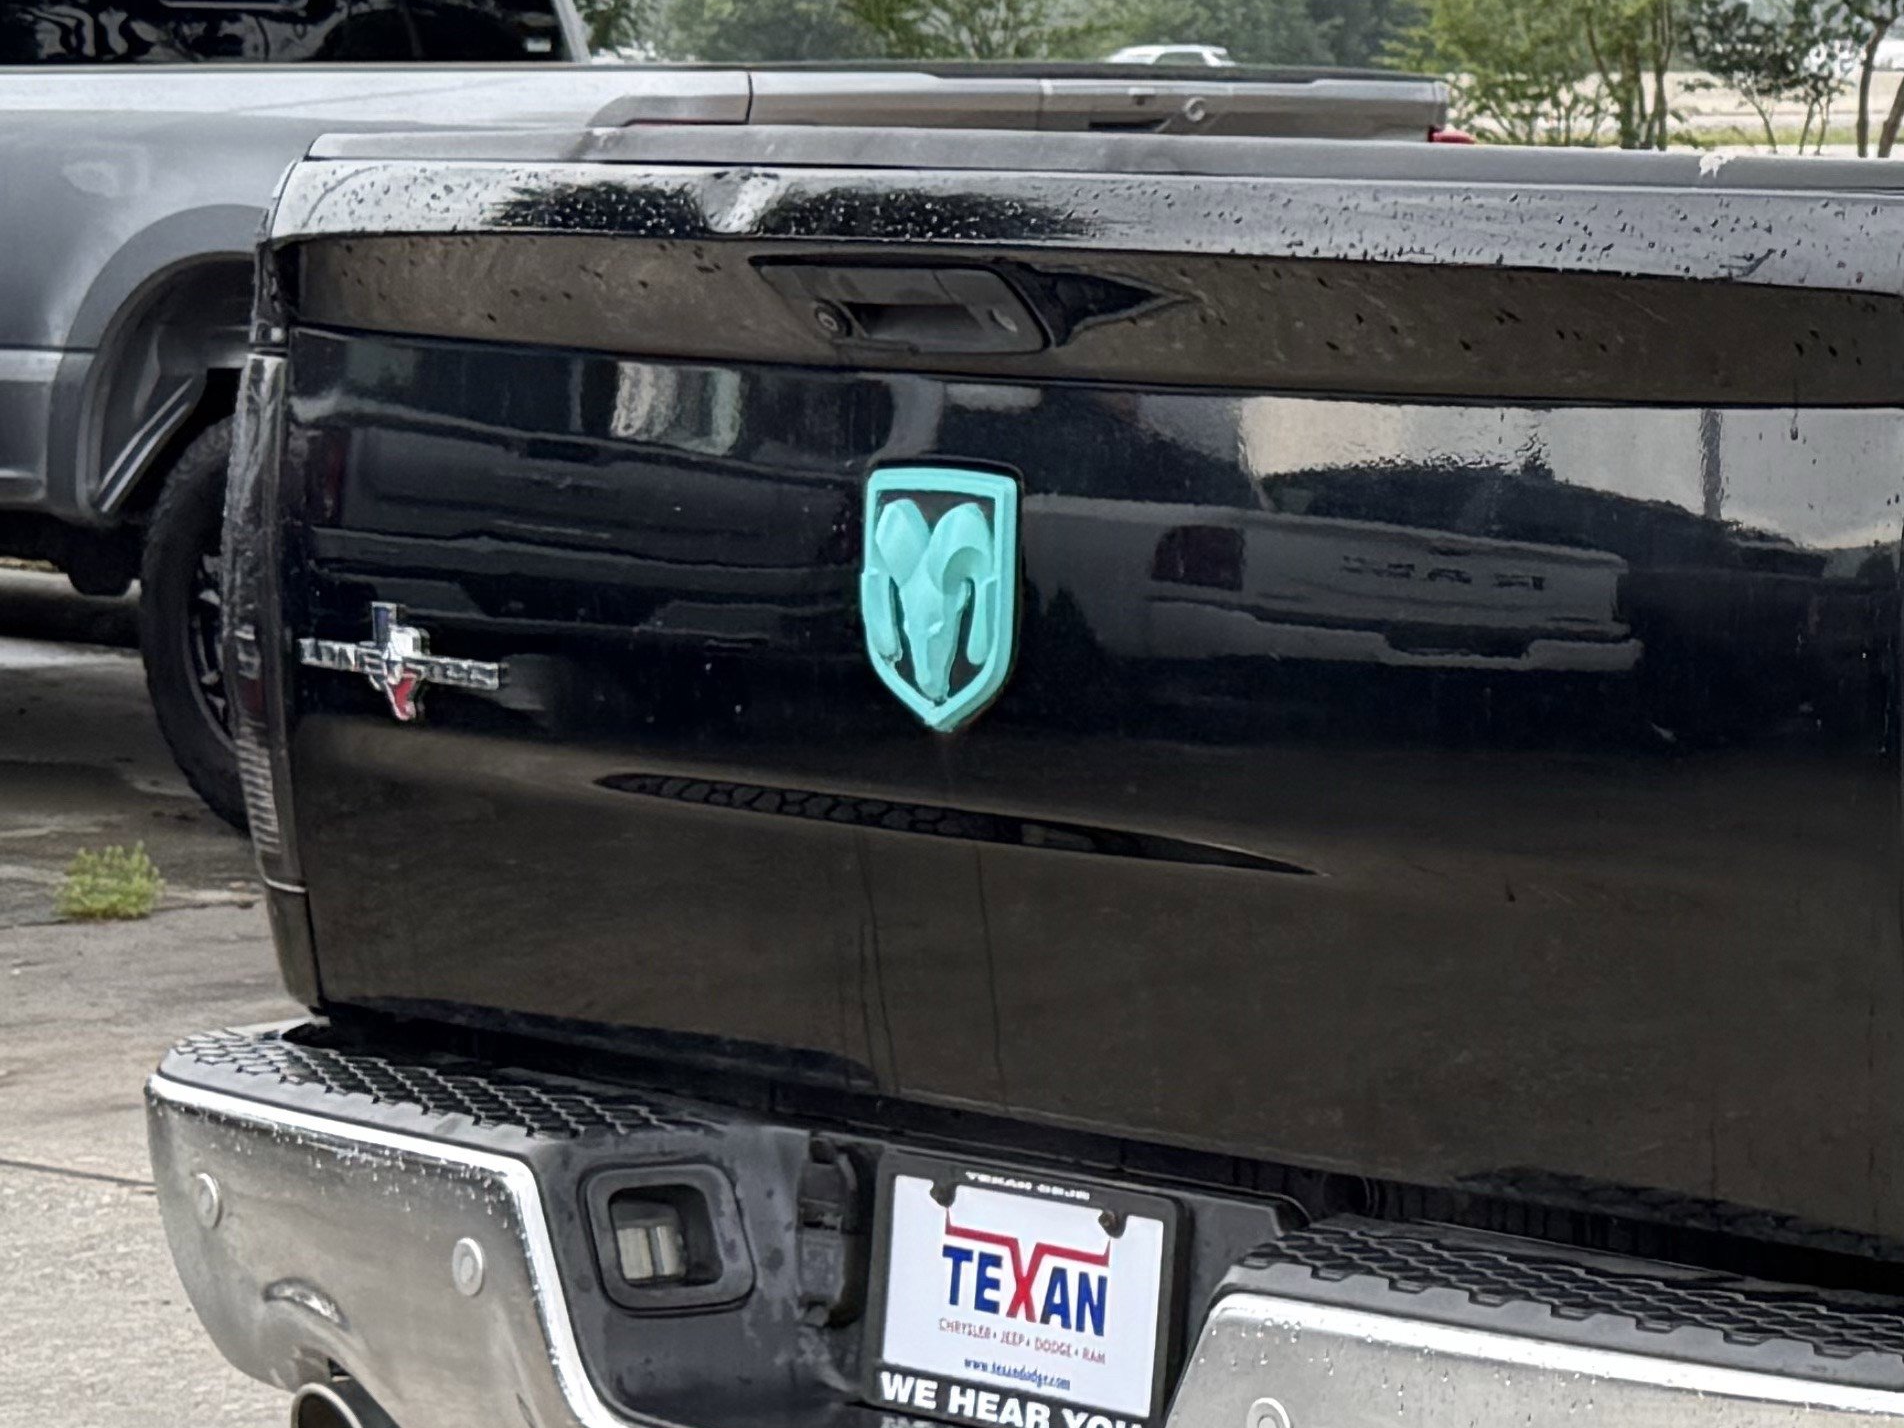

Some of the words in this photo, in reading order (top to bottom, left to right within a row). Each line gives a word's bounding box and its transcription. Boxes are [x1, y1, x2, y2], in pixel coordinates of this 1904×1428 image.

[942, 1224, 1110, 1337] TEXAN
[938, 1317, 991, 1342] CHRYSLER
[1000, 1329, 1026, 1348] JEEP
[1034, 1333, 1072, 1359] DODGE
[1082, 1347, 1106, 1365] RAM
[880, 1371, 938, 1411] WE
